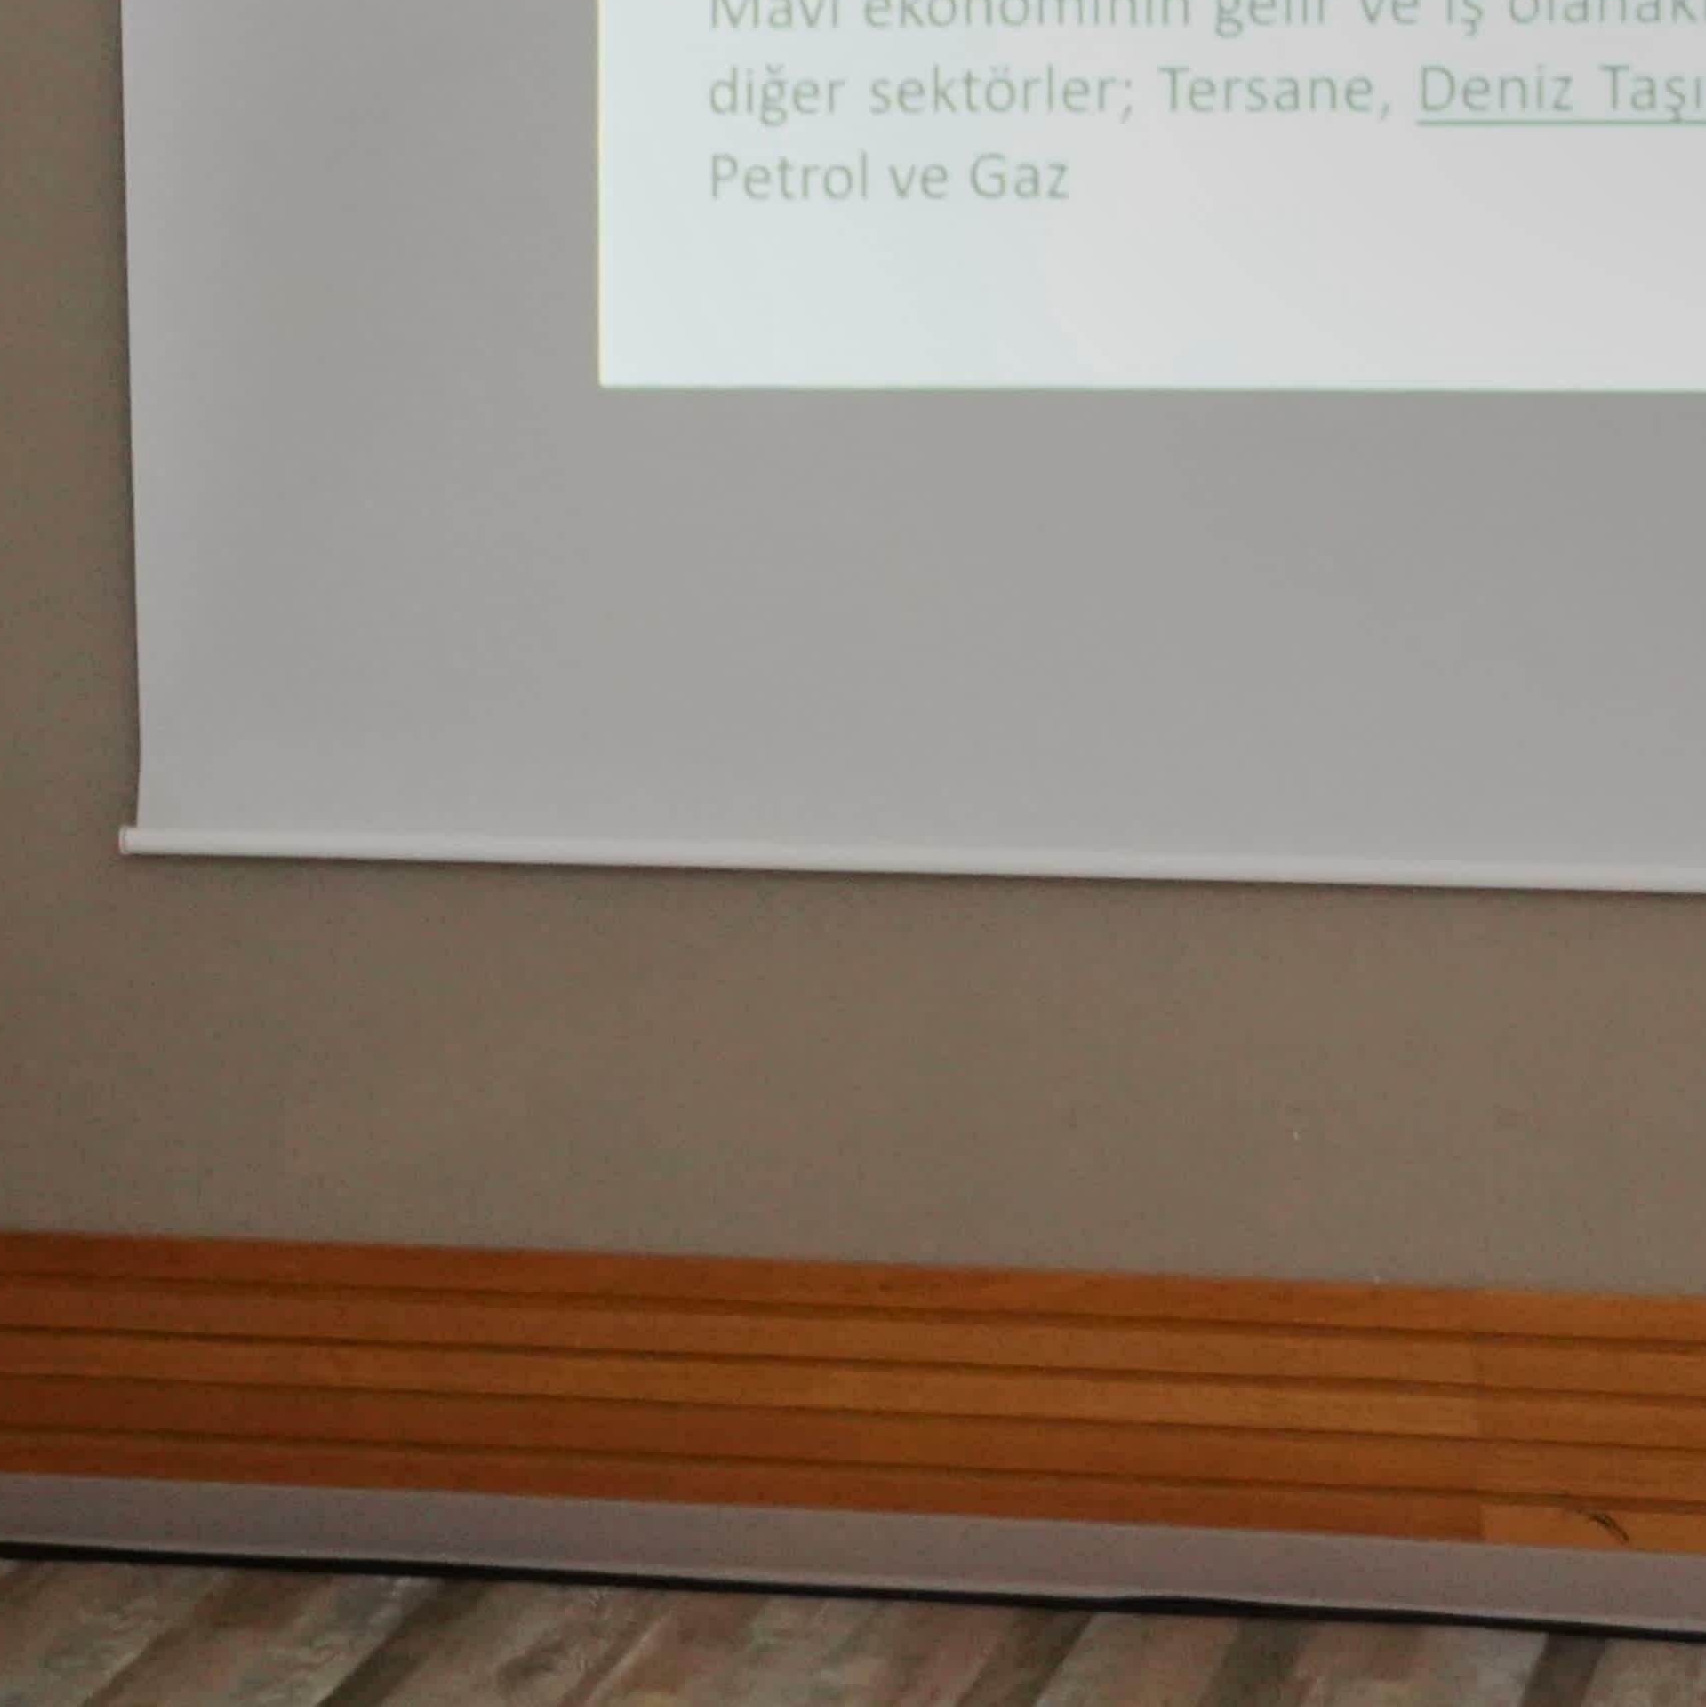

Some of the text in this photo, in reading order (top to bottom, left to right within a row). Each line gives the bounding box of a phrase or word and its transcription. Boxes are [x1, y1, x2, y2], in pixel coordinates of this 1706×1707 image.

[708, 63, 846, 128] diğer
[869, 64, 1133, 123] sektörler;
[1158, 65, 1396, 124] Tersane,
[1419, 63, 1573, 114] Deniz
[710, 151, 1069, 201] Petrol ve Gaz
